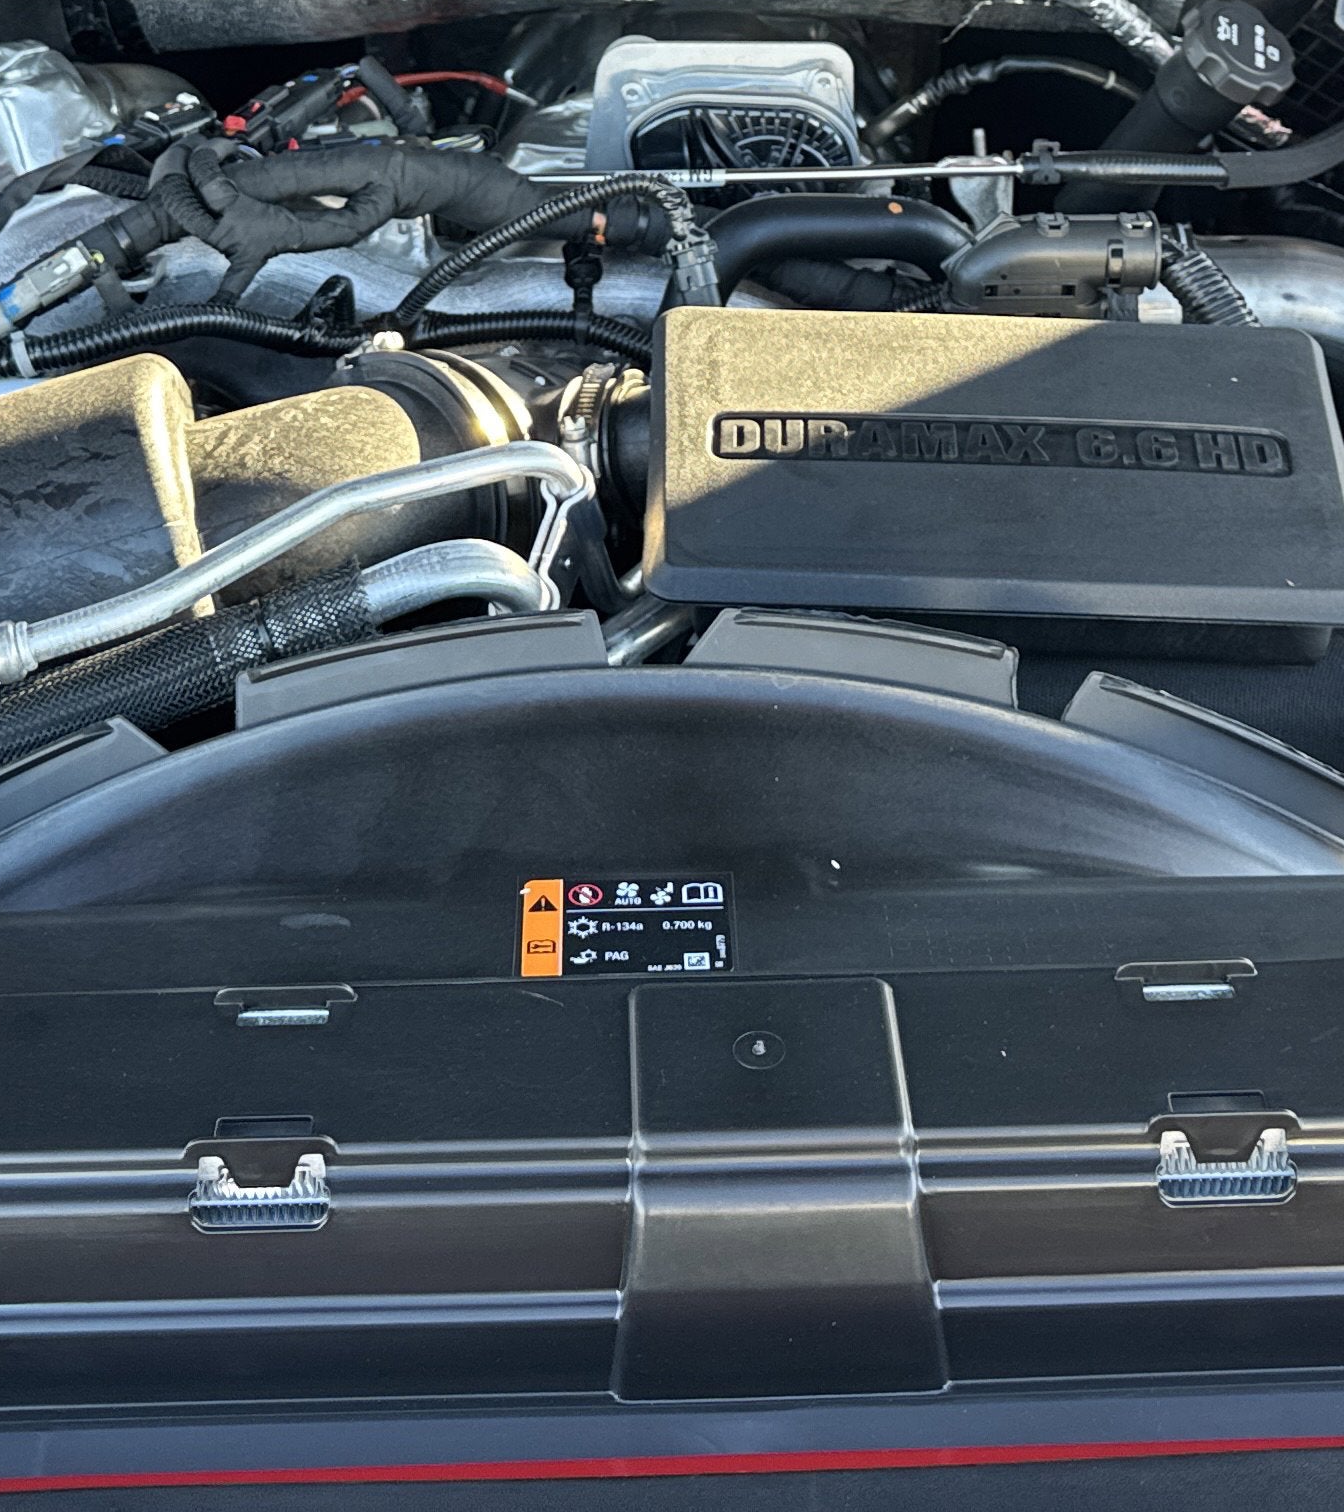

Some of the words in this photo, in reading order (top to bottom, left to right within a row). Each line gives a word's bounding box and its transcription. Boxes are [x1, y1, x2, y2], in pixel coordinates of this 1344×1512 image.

[720, 419, 1050, 462] DURAMAX
[1075, 427, 1179, 467] 6.6
[1193, 432, 1283, 473] HD
[615, 897, 642, 905] AUTO
[602, 922, 644, 931] R-134a
[662, 920, 695, 930] 0.700
[698, 920, 712, 930] kg
[604, 951, 629, 961] PAG
